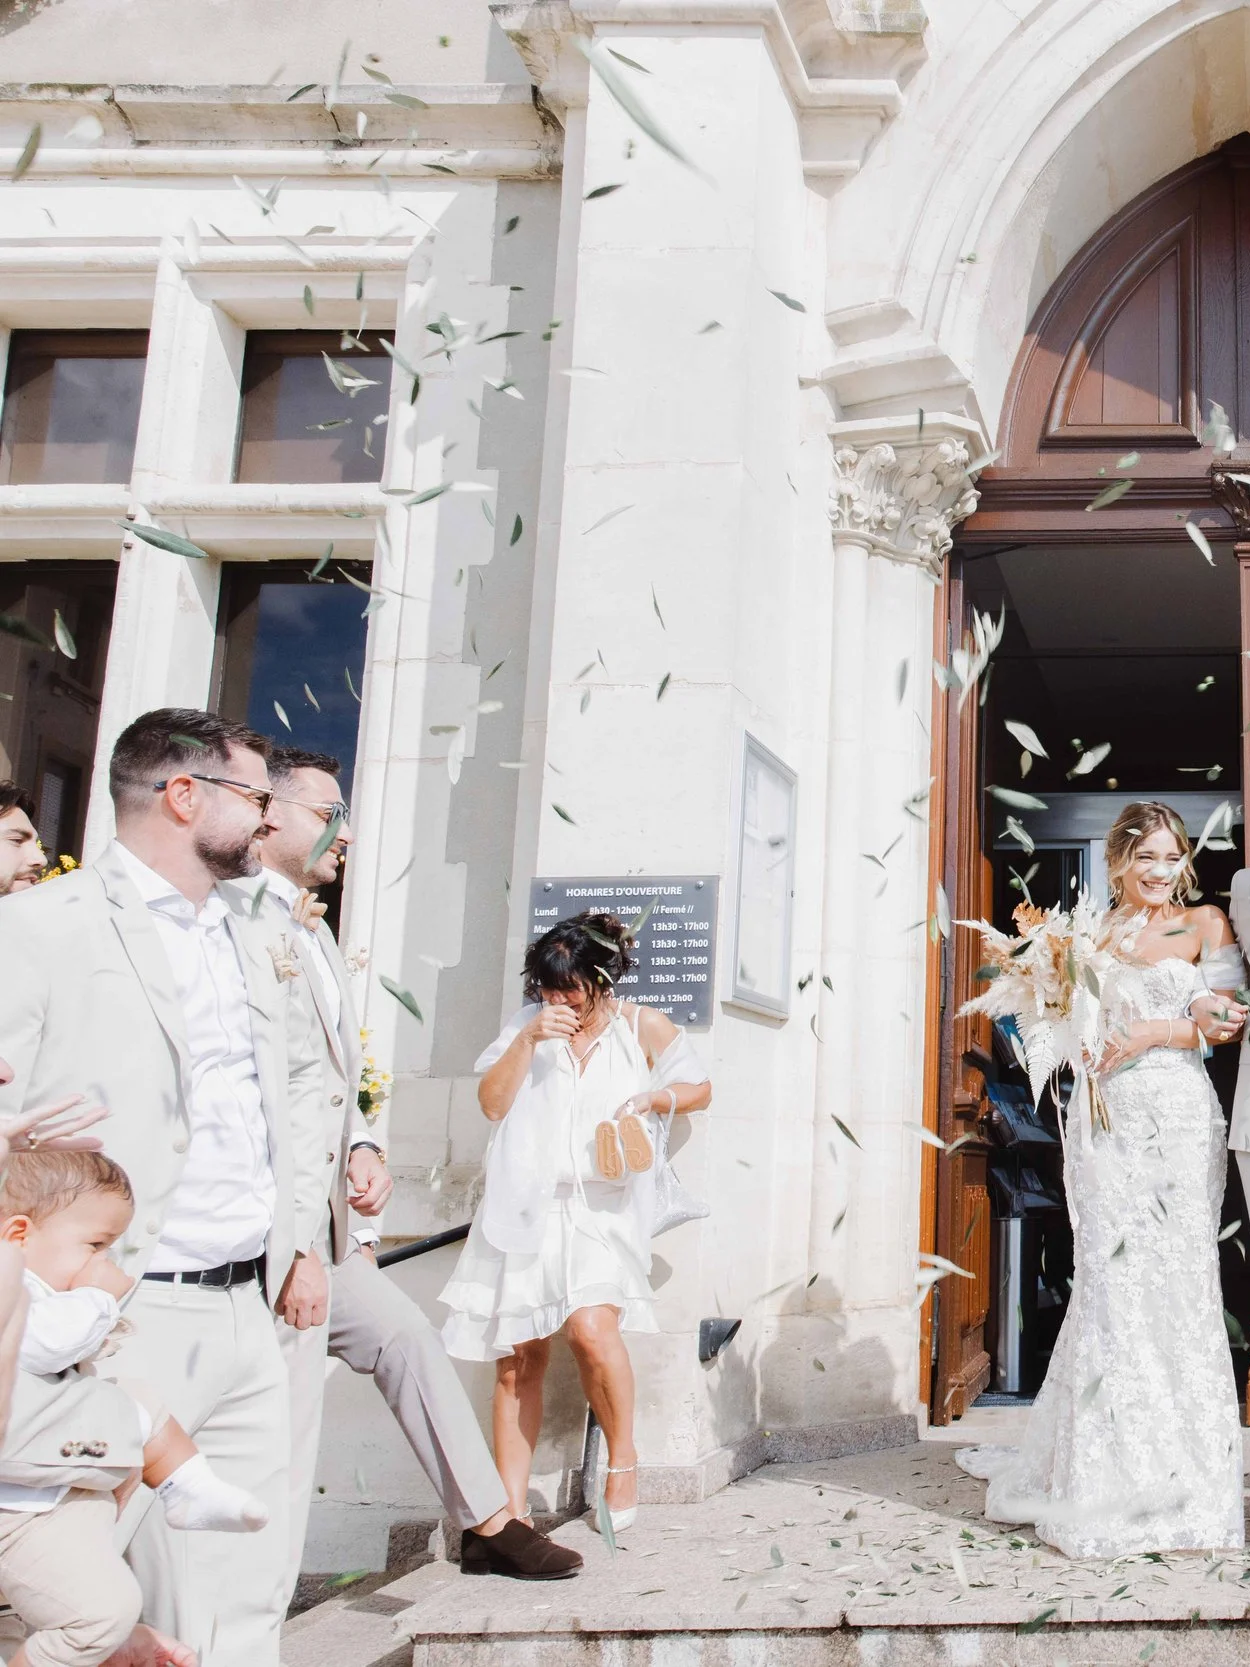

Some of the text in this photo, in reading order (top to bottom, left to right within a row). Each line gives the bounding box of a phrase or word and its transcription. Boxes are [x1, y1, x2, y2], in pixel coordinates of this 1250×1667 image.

[566, 886, 682, 897] HORAIRES D'OUVERTURE
[534, 906, 558, 916] Lundi
[590, 906, 610, 915] 8h30
[616, 906, 642, 914] 12h00
[660, 904, 686, 914] Fermé
[534, 924, 558, 934] Mar
[652, 922, 678, 931] 13h30
[684, 922, 709, 930] 17h00
[652, 940, 676, 948] 13h30
[683, 939, 708, 948] 17h00
[651, 957, 676, 966] 13h30
[682, 956, 708, 965] 17h00
[650, 974, 676, 983] 13h30
[682, 974, 707, 982] 17h00
[626, 995, 638, 1003] de
[638, 994, 659, 1003] 9h00
[668, 994, 693, 1002] 12h00
